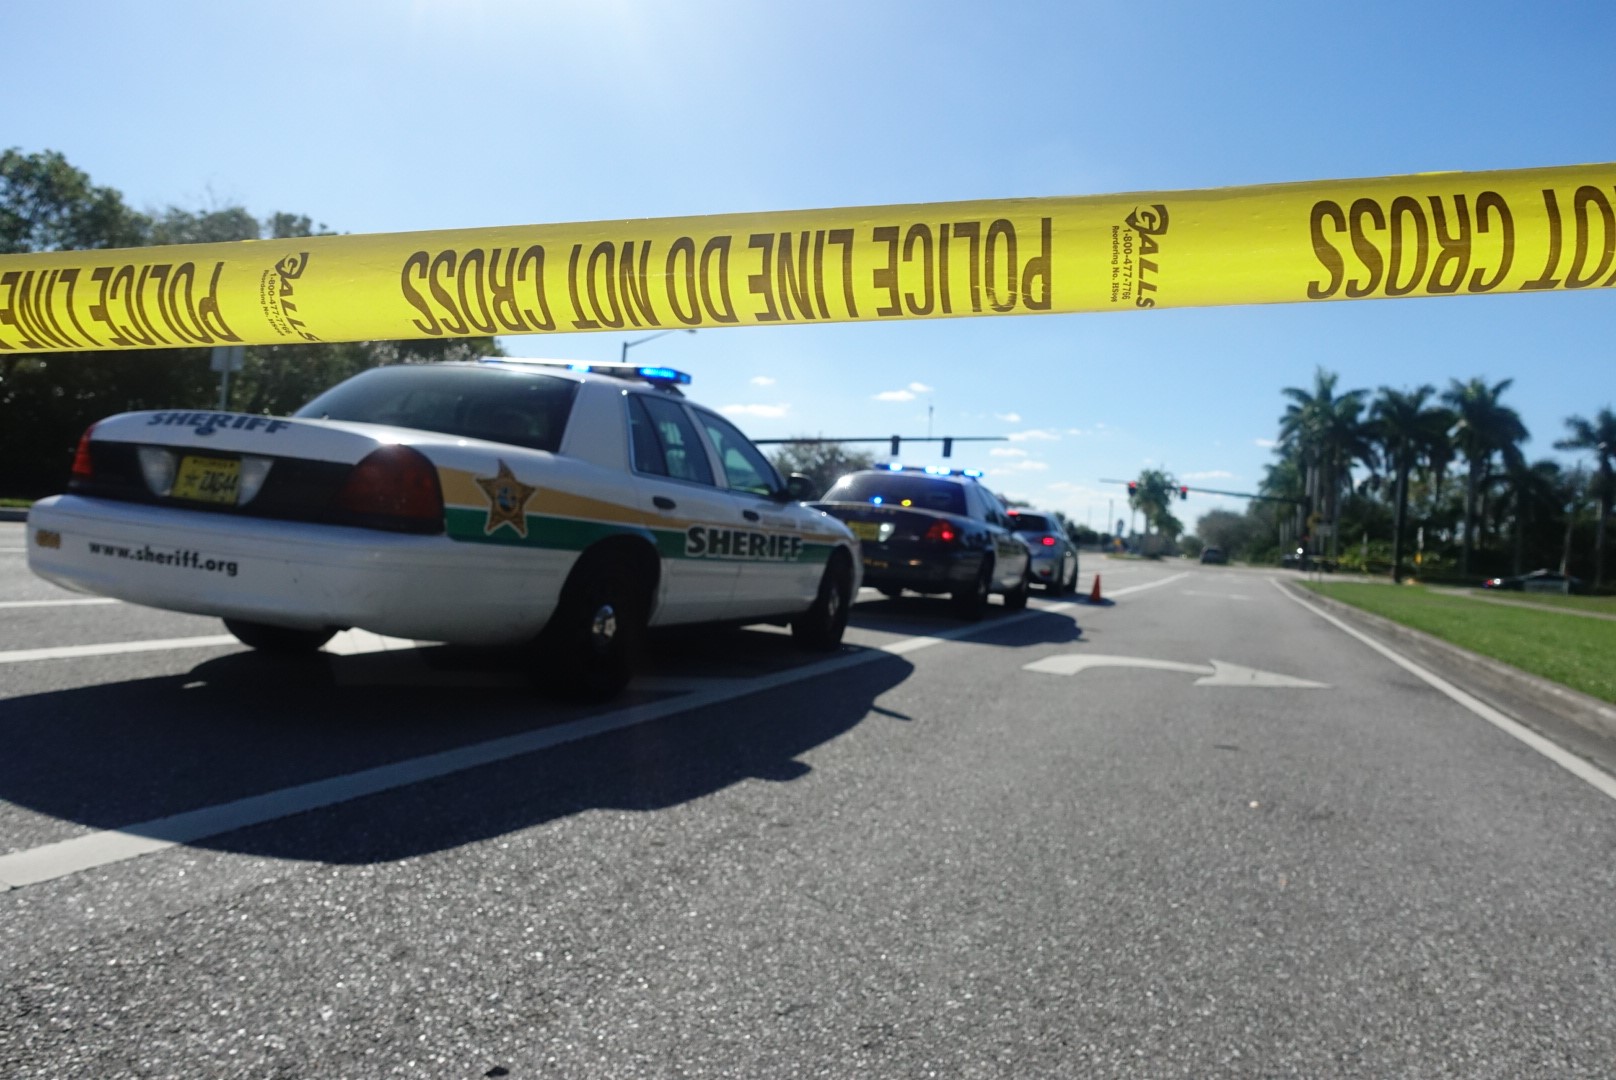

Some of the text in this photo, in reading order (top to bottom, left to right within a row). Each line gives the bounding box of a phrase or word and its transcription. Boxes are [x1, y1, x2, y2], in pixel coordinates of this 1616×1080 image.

[402, 217, 1053, 335] POLICE LINE DO NOT CROSS
[1111, 225, 1120, 265] Reordering
[1112, 267, 1120, 281] No.
[1122, 228, 1133, 301] 1-800-477-7766
[1126, 204, 1169, 308] GALLS
[1307, 185, 1616, 300] OT CROSS
[0, 262, 243, 349] POLICE LINE
[275, 252, 321, 341] GALLS
[147, 412, 291, 433] SHERIFF
[88, 541, 238, 577] www.sheriff.org
[686, 526, 803, 559] SHERIFF
